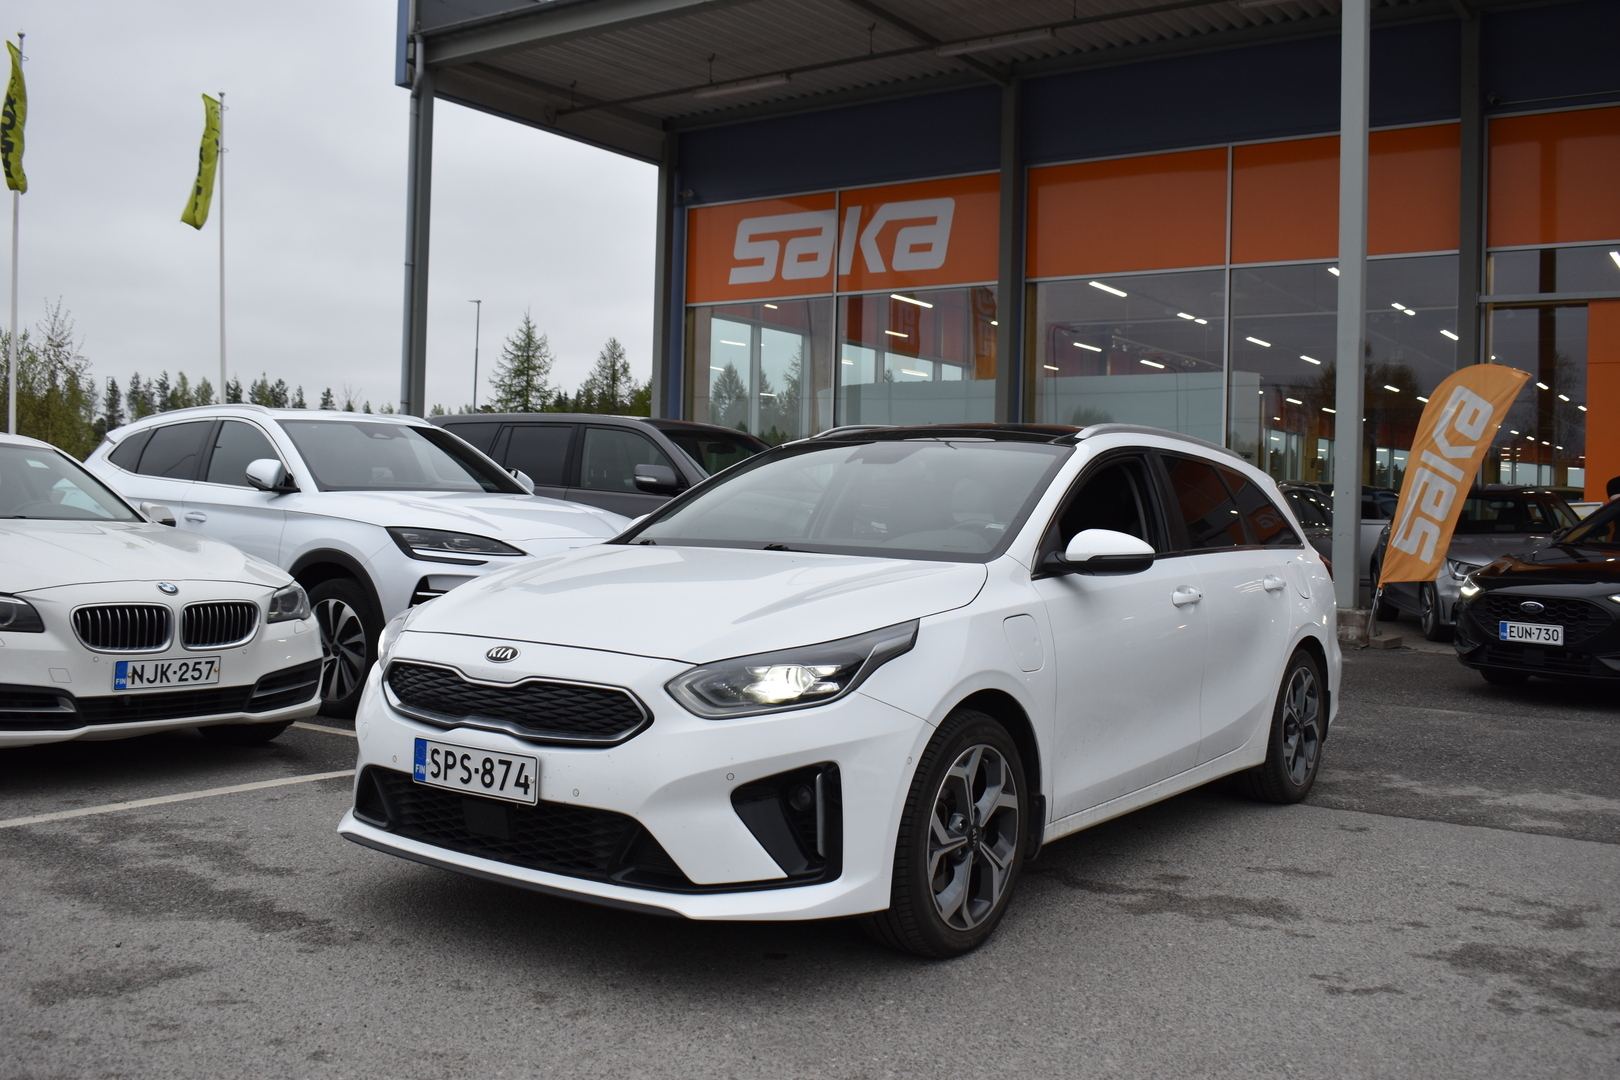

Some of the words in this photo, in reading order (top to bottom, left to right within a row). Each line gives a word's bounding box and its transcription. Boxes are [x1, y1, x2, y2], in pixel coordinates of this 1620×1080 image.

[1509, 625, 1559, 642] EUN-730
[488, 647, 514, 660] KIA
[131, 660, 216, 685] NJK-257
[415, 763, 426, 775] FIN
[430, 748, 530, 795] SPS-874
